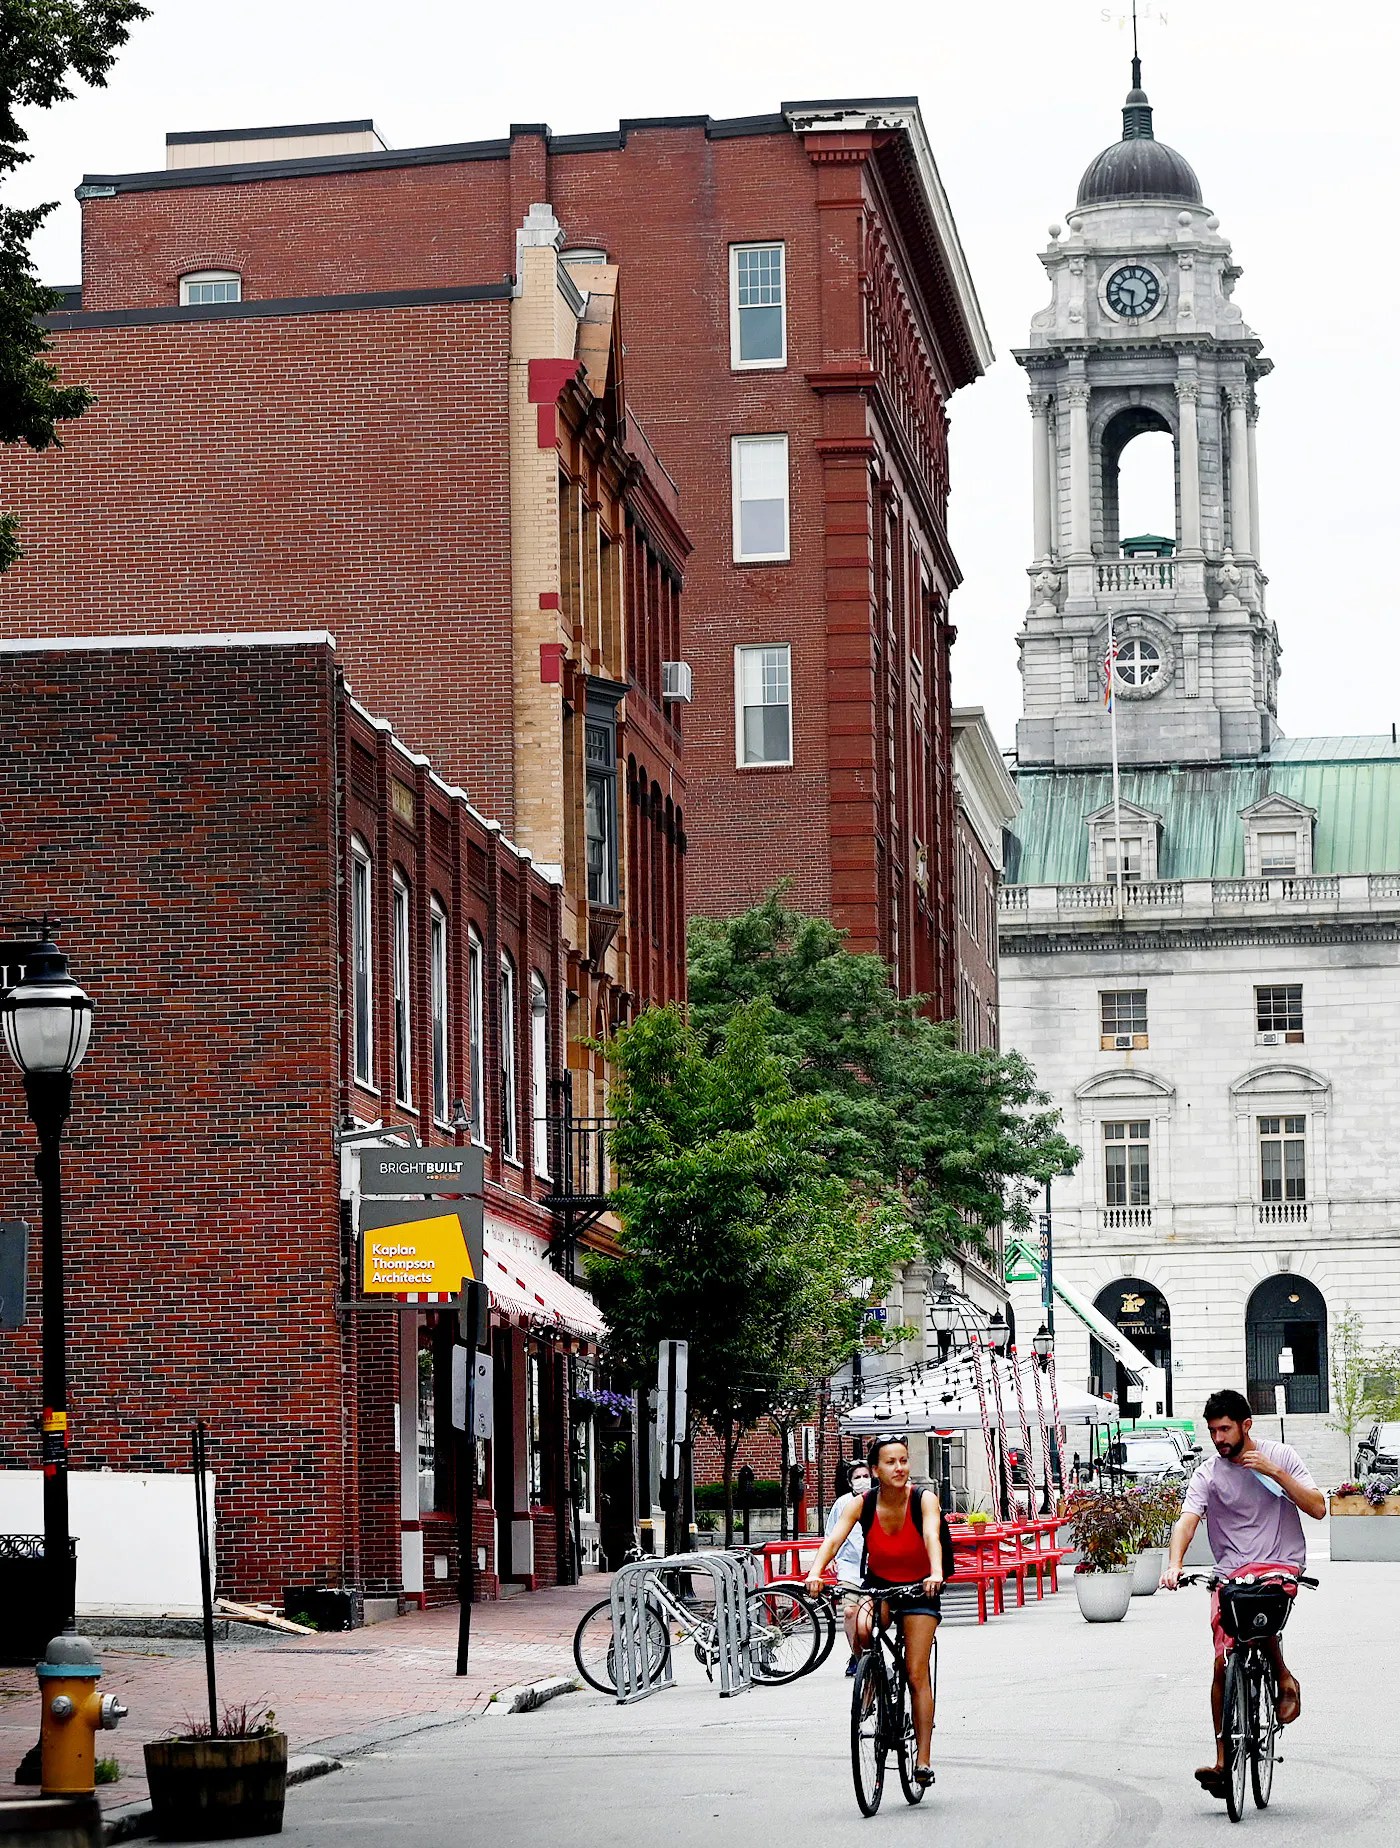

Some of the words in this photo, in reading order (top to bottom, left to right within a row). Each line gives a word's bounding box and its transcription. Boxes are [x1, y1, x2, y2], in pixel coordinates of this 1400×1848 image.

[380, 1162, 464, 1174] BRIGHTBUILT
[372, 1244, 416, 1257] Kaplan
[372, 1257, 435, 1271] Thompson
[372, 1272, 432, 1283] Architects
[863, 1309, 877, 1323] ral
[1131, 1326, 1156, 1335] HALL
